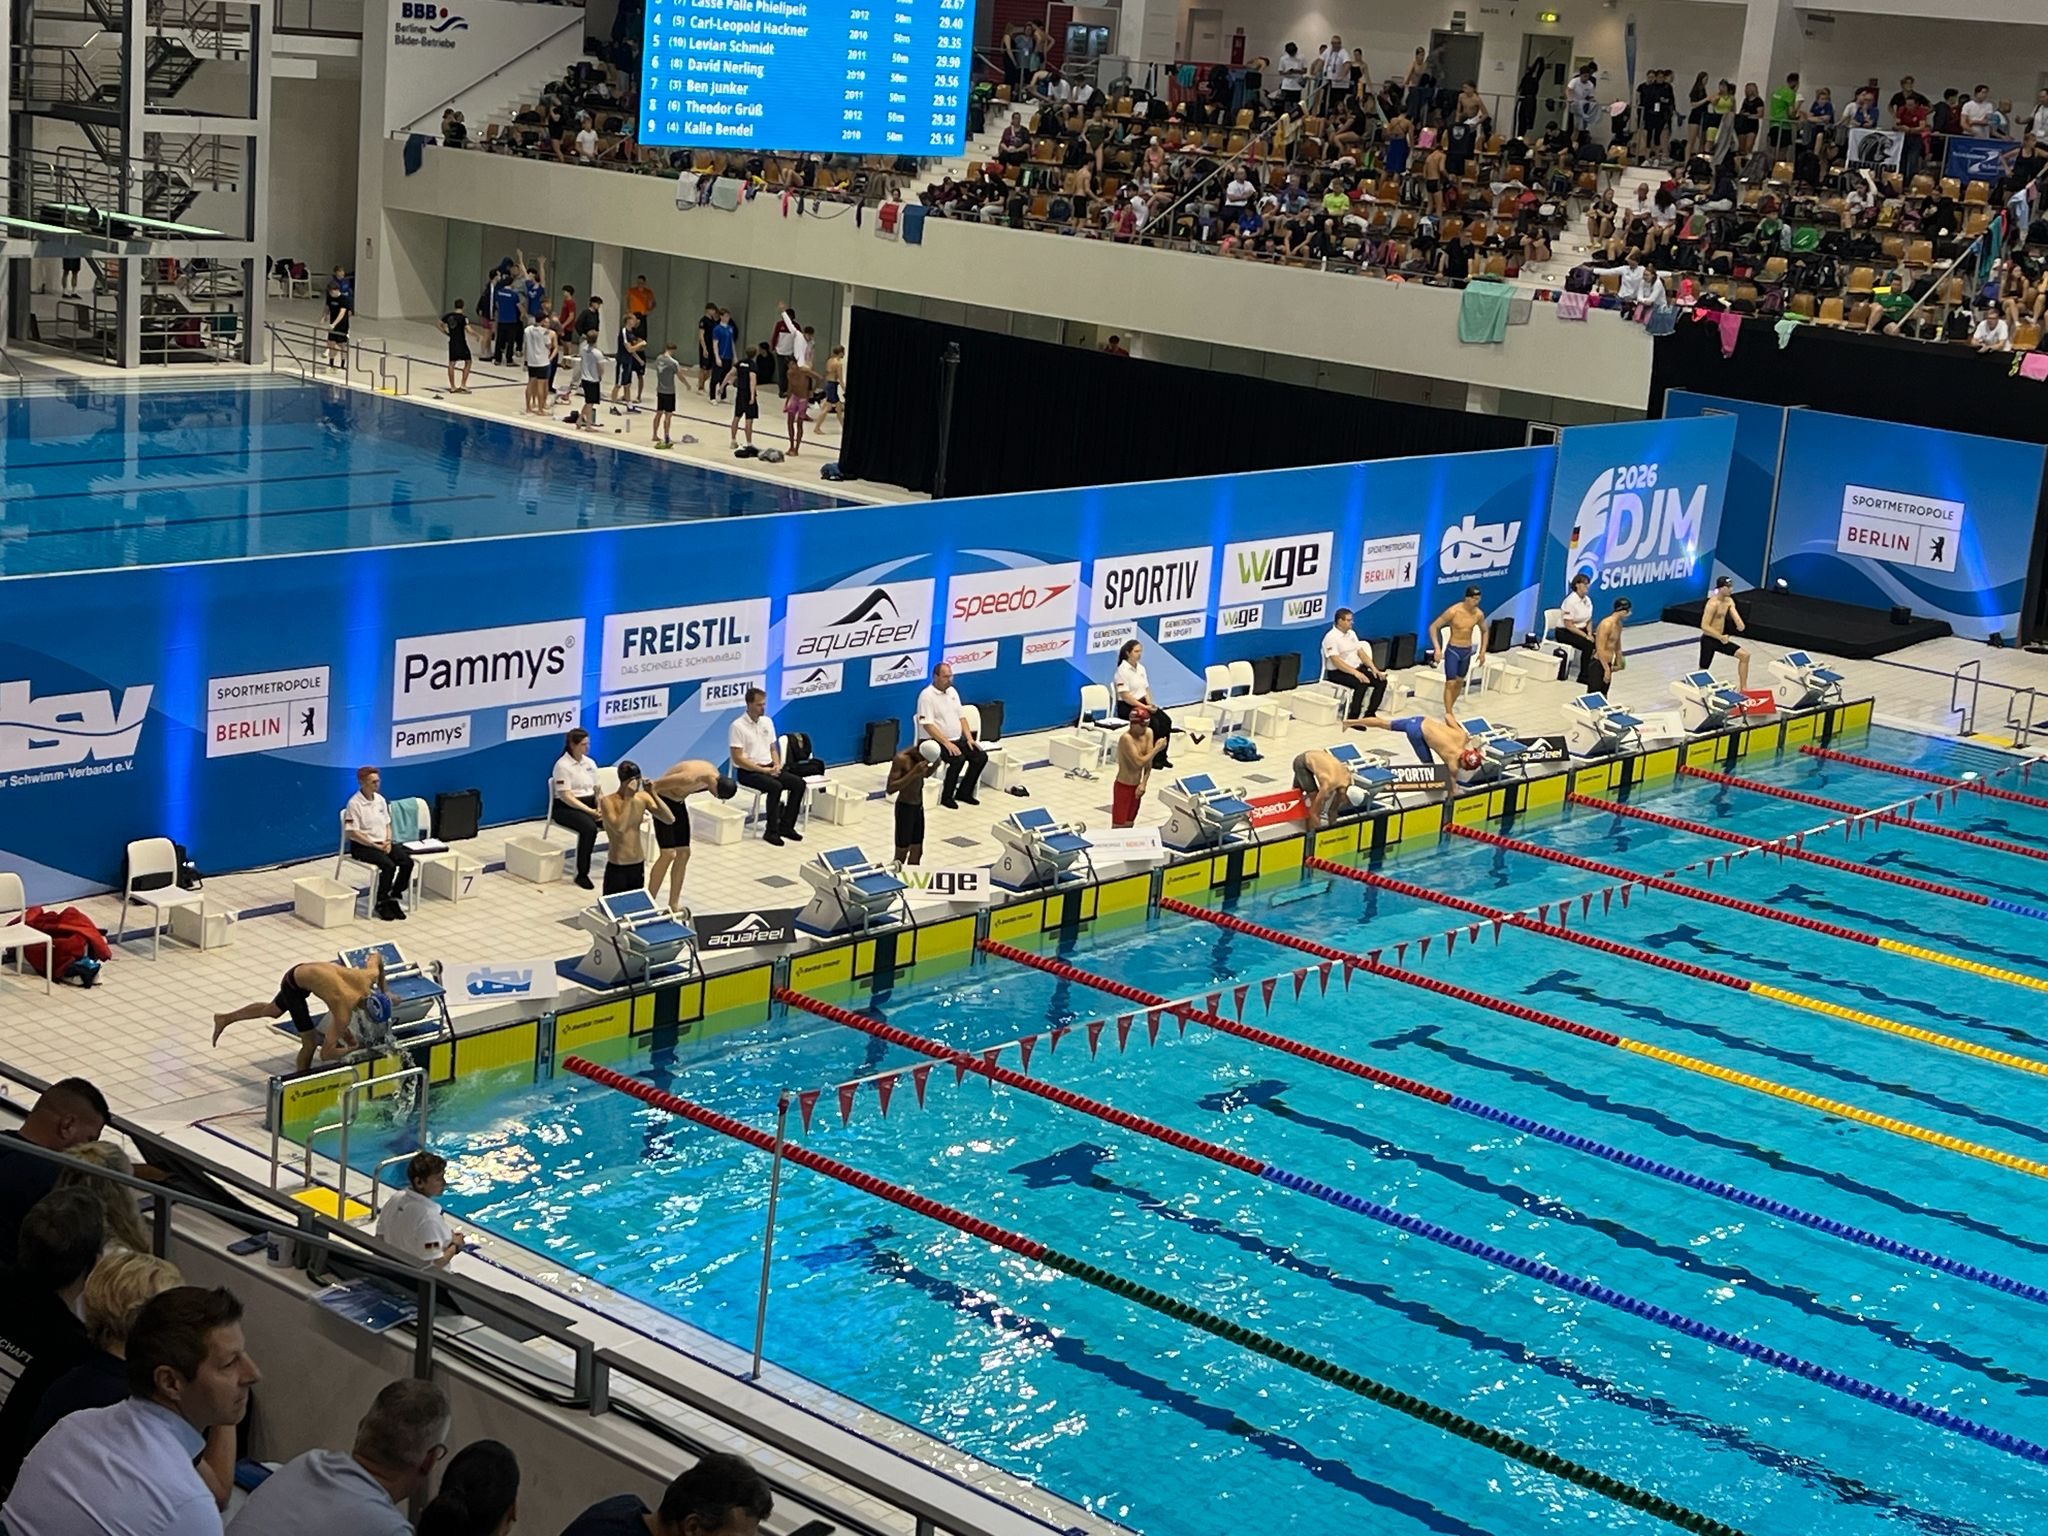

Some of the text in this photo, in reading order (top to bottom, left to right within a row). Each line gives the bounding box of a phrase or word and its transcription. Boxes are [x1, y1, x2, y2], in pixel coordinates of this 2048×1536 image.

[402, 2, 437, 20] BBB
[395, 22, 427, 34] Berliner
[653, 13, 661, 25] 4
[672, 15, 685, 28] (5)
[690, 15, 761, 35] Carl-Leopold
[763, 22, 808, 37] Hackner
[937, 36, 961, 50] 29.35
[939, 16, 963, 30] 29.40
[394, 34, 456, 49] Bäder-Betriebe
[652, 34, 660, 47] 5
[668, 36, 686, 49] (10)
[689, 37, 726, 52] Levian
[729, 40, 774, 55] Schmidt
[651, 55, 659, 69] 6
[670, 57, 683, 70] (8)
[688, 58, 720, 73] David
[722, 61, 765, 79] Nerling
[934, 75, 959, 89] 29.56
[650, 77, 658, 90] 7
[669, 79, 682, 92] (3)
[686, 79, 708, 93] Ben
[709, 81, 748, 97] Junker
[932, 94, 957, 108] 29.15
[648, 98, 657, 111] 8
[667, 100, 680, 113] (6)
[685, 100, 733, 115] Theodor
[735, 102, 763, 117] Grüß
[931, 114, 956, 127] 29.38
[647, 119, 655, 132] 9
[666, 122, 679, 134] (4)
[684, 121, 713, 135] Kalle
[715, 123, 753, 137] Bendel
[930, 132, 954, 145] 29.16
[1614, 463, 1658, 491] 2026
[1851, 494, 1955, 521] SPORTMETROPOLE
[1604, 484, 1707, 564] DJM
[1847, 526, 1910, 552] BERLIN
[1104, 559, 1199, 610] SPORTIV
[1365, 568, 1395, 584] BERLIN
[1600, 555, 1696, 591] SCHWIMMEN
[952, 585, 1037, 623] speedo
[622, 616, 750, 658] FREISTIL.
[797, 619, 920, 658] aquafeel
[1025, 640, 1058, 655] speedo
[946, 651, 979, 666] speedo
[875, 666, 923, 684] aquafeel
[217, 675, 321, 701] SPORTMETROPOLE
[786, 679, 837, 697] aquafeel
[216, 717, 281, 742] BERLIN
[1571, 731, 1579, 743] 2
[10, 762, 113, 787] Schwimm-Verband
[115, 761, 134, 773] e.V.
[1170, 819, 1179, 833] 5
[1004, 857, 1012, 871] 6
[462, 875, 474, 895] 7
[815, 898, 823, 913] 7
[708, 927, 784, 947] aquafeel
[594, 949, 602, 965] 8
